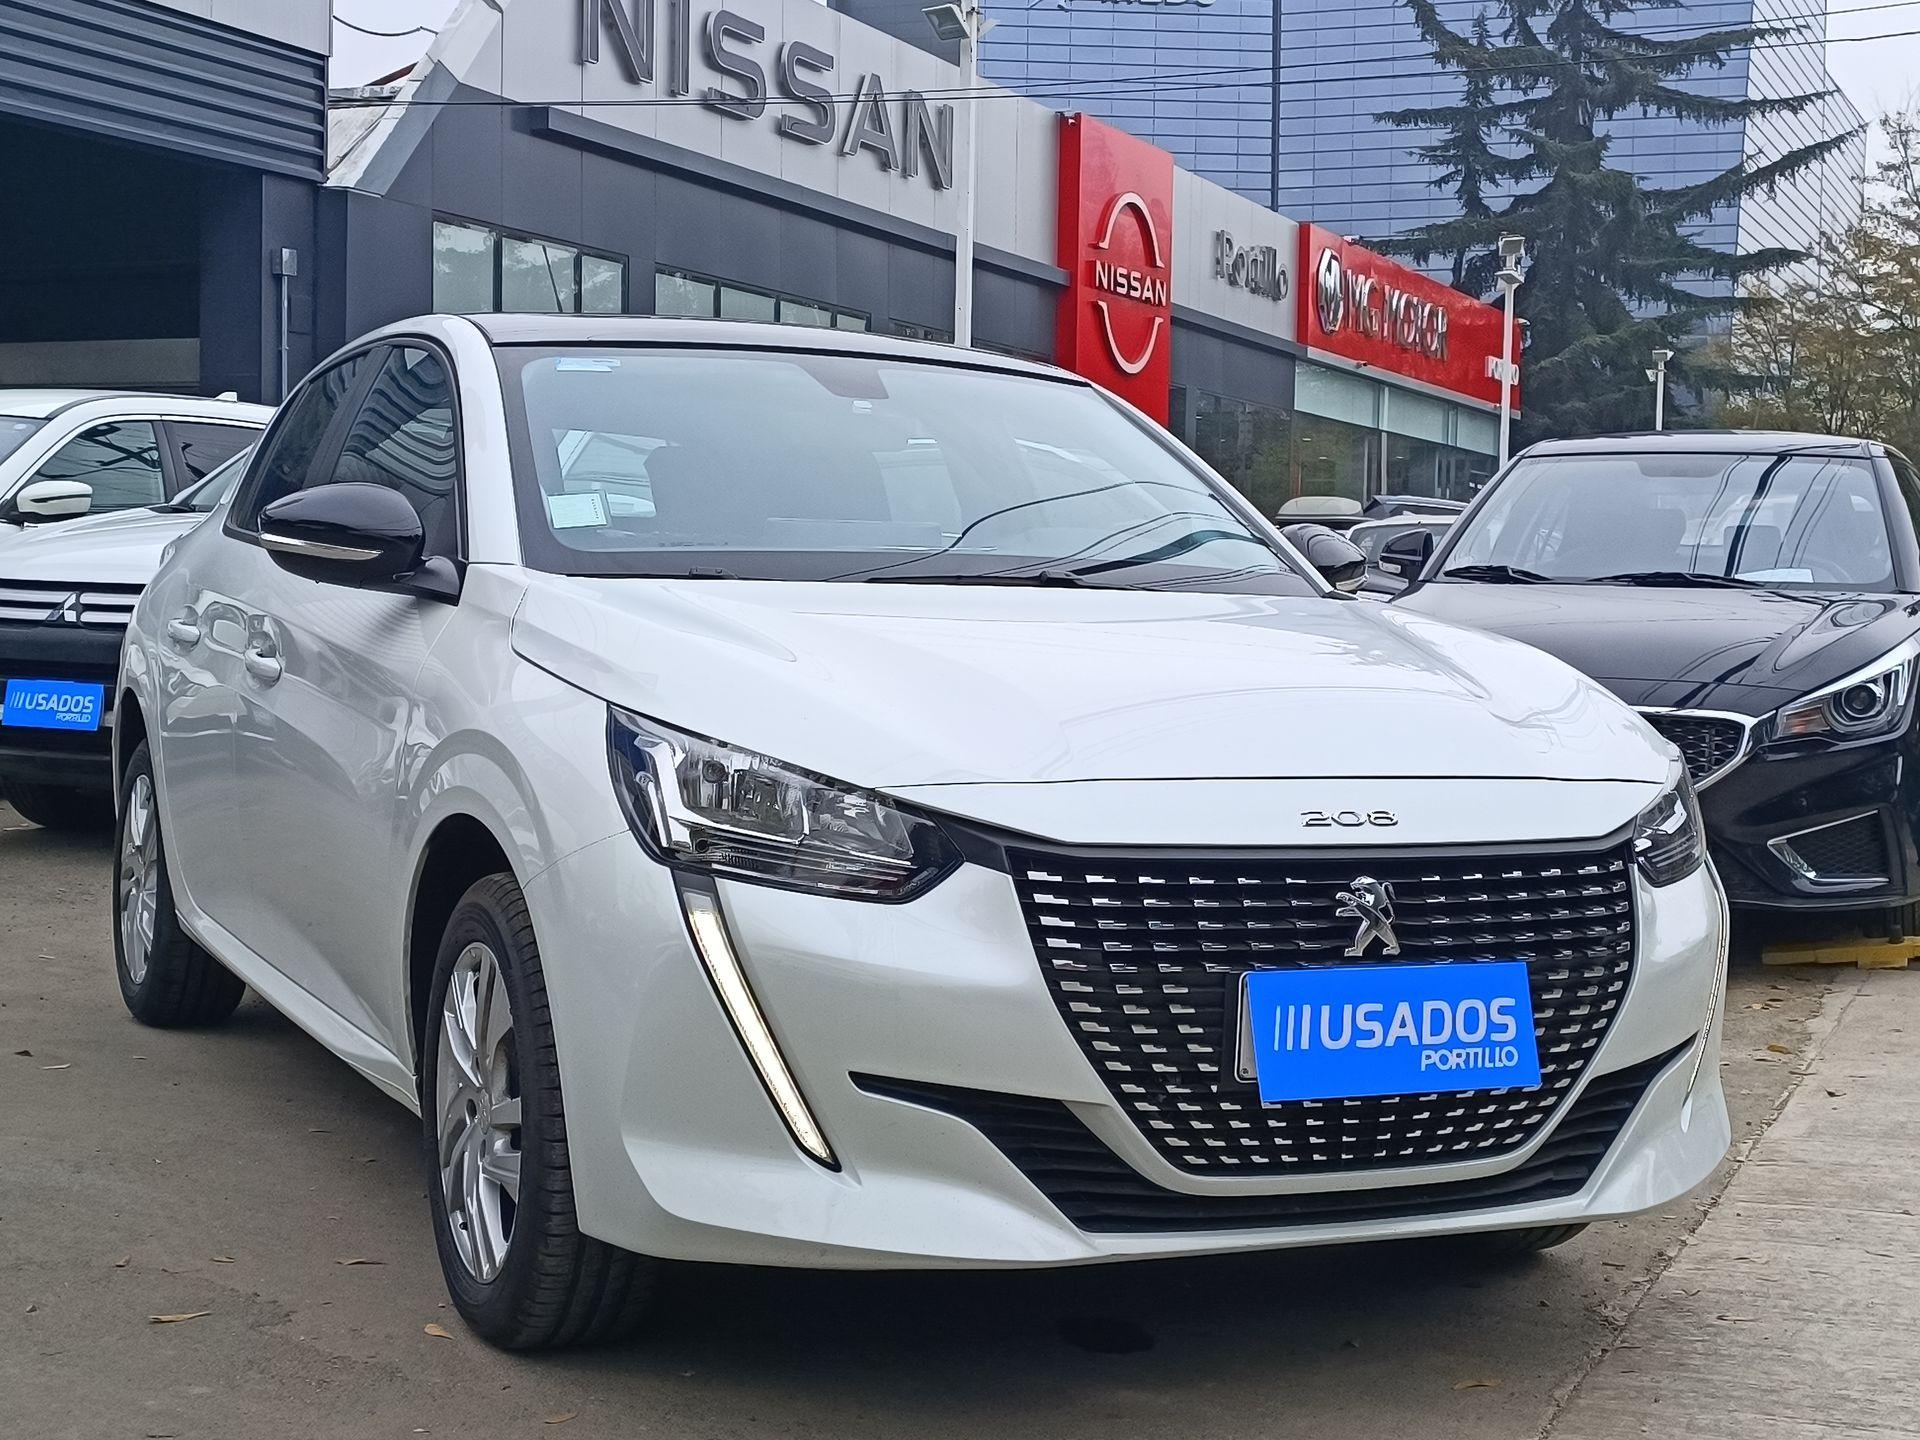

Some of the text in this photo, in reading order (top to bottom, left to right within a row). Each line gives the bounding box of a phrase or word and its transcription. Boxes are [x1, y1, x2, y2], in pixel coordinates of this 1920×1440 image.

[582, 0, 954, 190] NISSAN
[1095, 259, 1167, 307] NISSAN
[1216, 230, 1289, 301] Portillo
[1343, 268, 1381, 337] MG
[1383, 283, 1448, 361] MOTOR
[25, 692, 95, 713] USADOS
[1300, 810, 1399, 828] 208
[1320, 998, 1518, 1050] USADOS
[1420, 1045, 1519, 1072] PORTILLO
